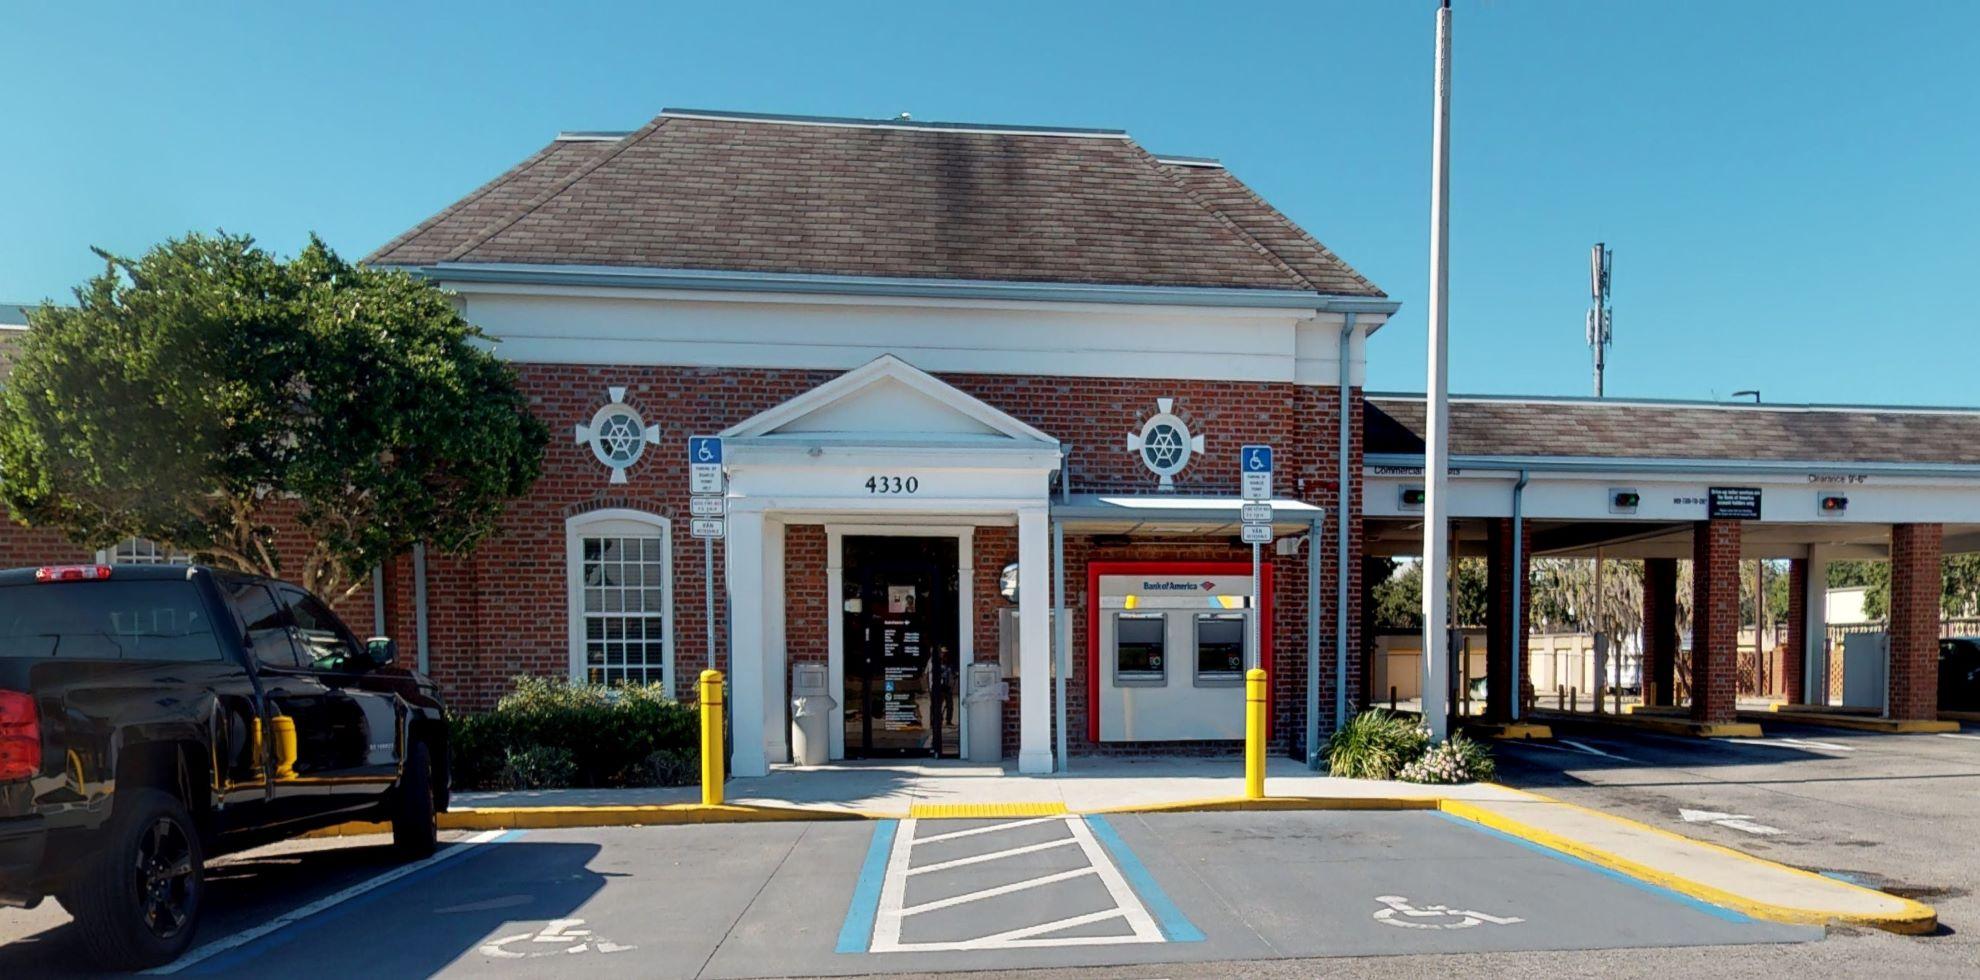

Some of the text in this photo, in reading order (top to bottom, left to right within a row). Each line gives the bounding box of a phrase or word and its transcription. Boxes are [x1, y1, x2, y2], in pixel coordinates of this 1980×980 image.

[865, 476, 918, 493] 4330
[1143, 582, 1198, 590] Bank of America
